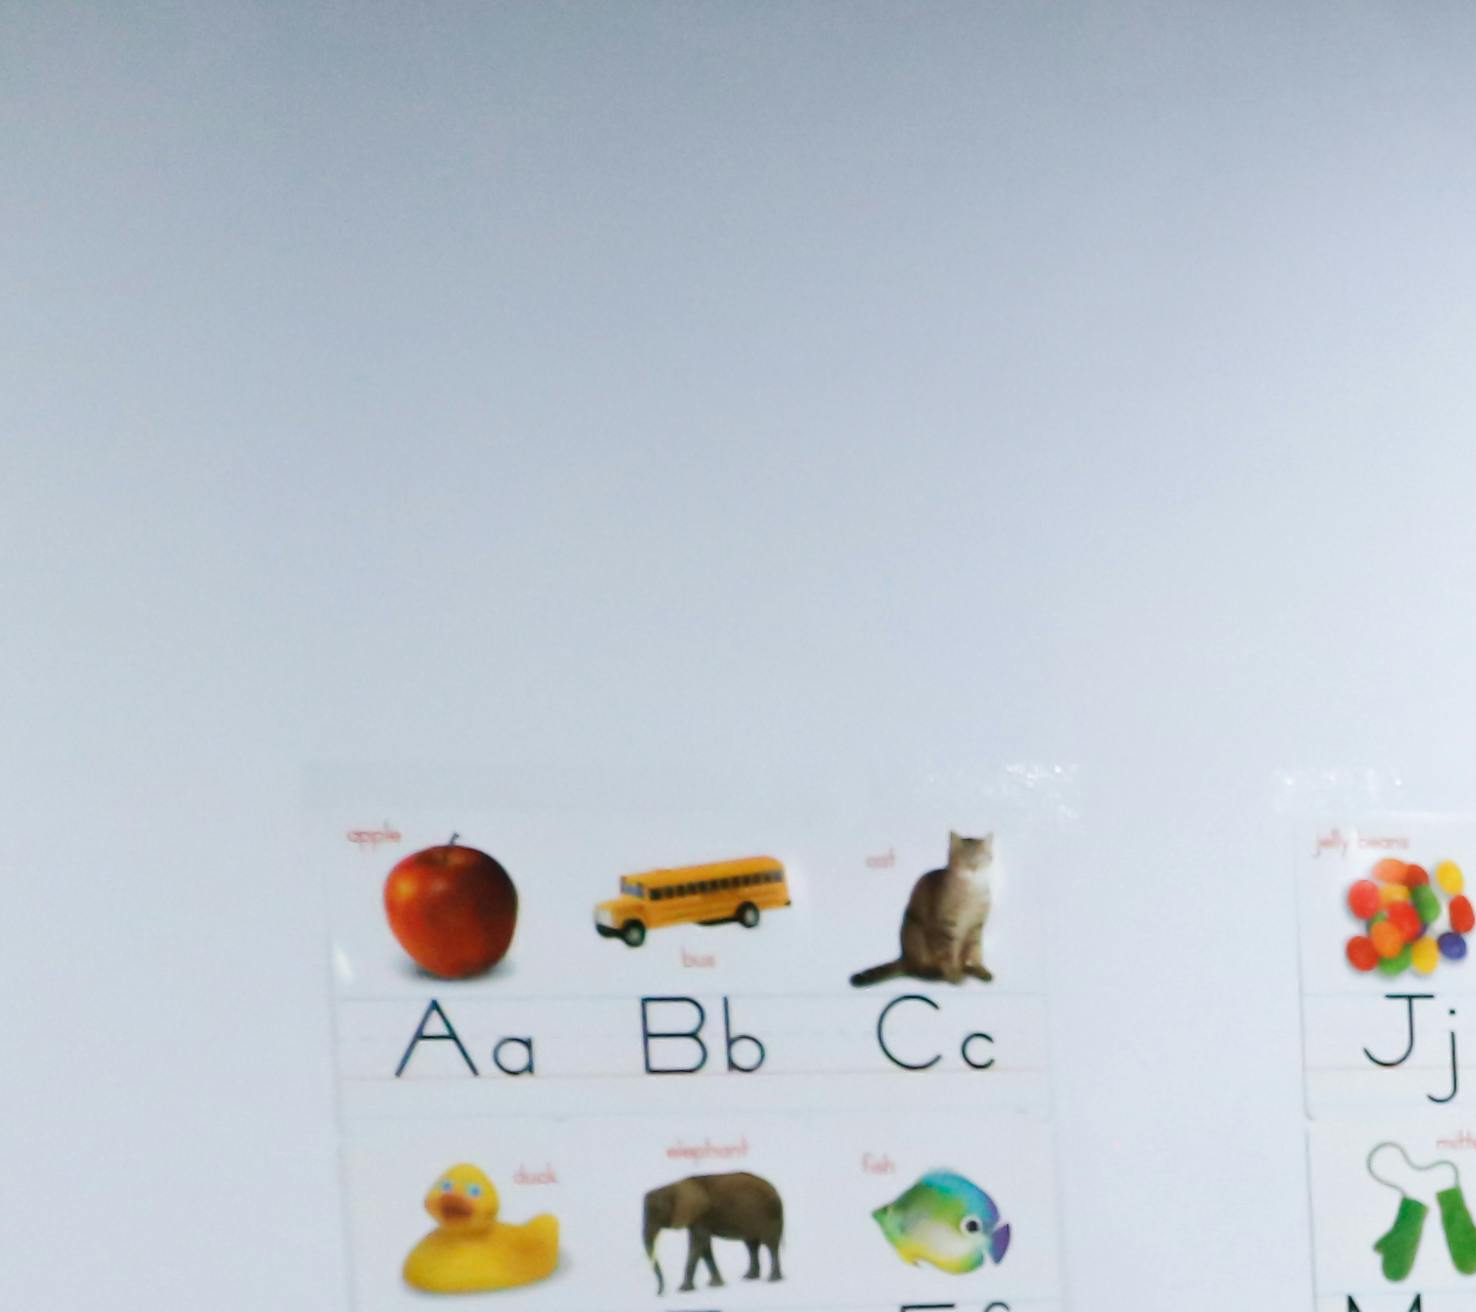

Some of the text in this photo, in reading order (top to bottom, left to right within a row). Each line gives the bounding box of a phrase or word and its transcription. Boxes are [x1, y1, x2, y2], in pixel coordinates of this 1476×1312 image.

[346, 820, 404, 852] apple
[1312, 828, 1411, 859] jelly beans
[866, 847, 897, 870] cat
[679, 946, 717, 969] bus
[665, 1136, 749, 1165] elephant
[511, 1163, 559, 1186] duck
[860, 1151, 896, 1176] fish
